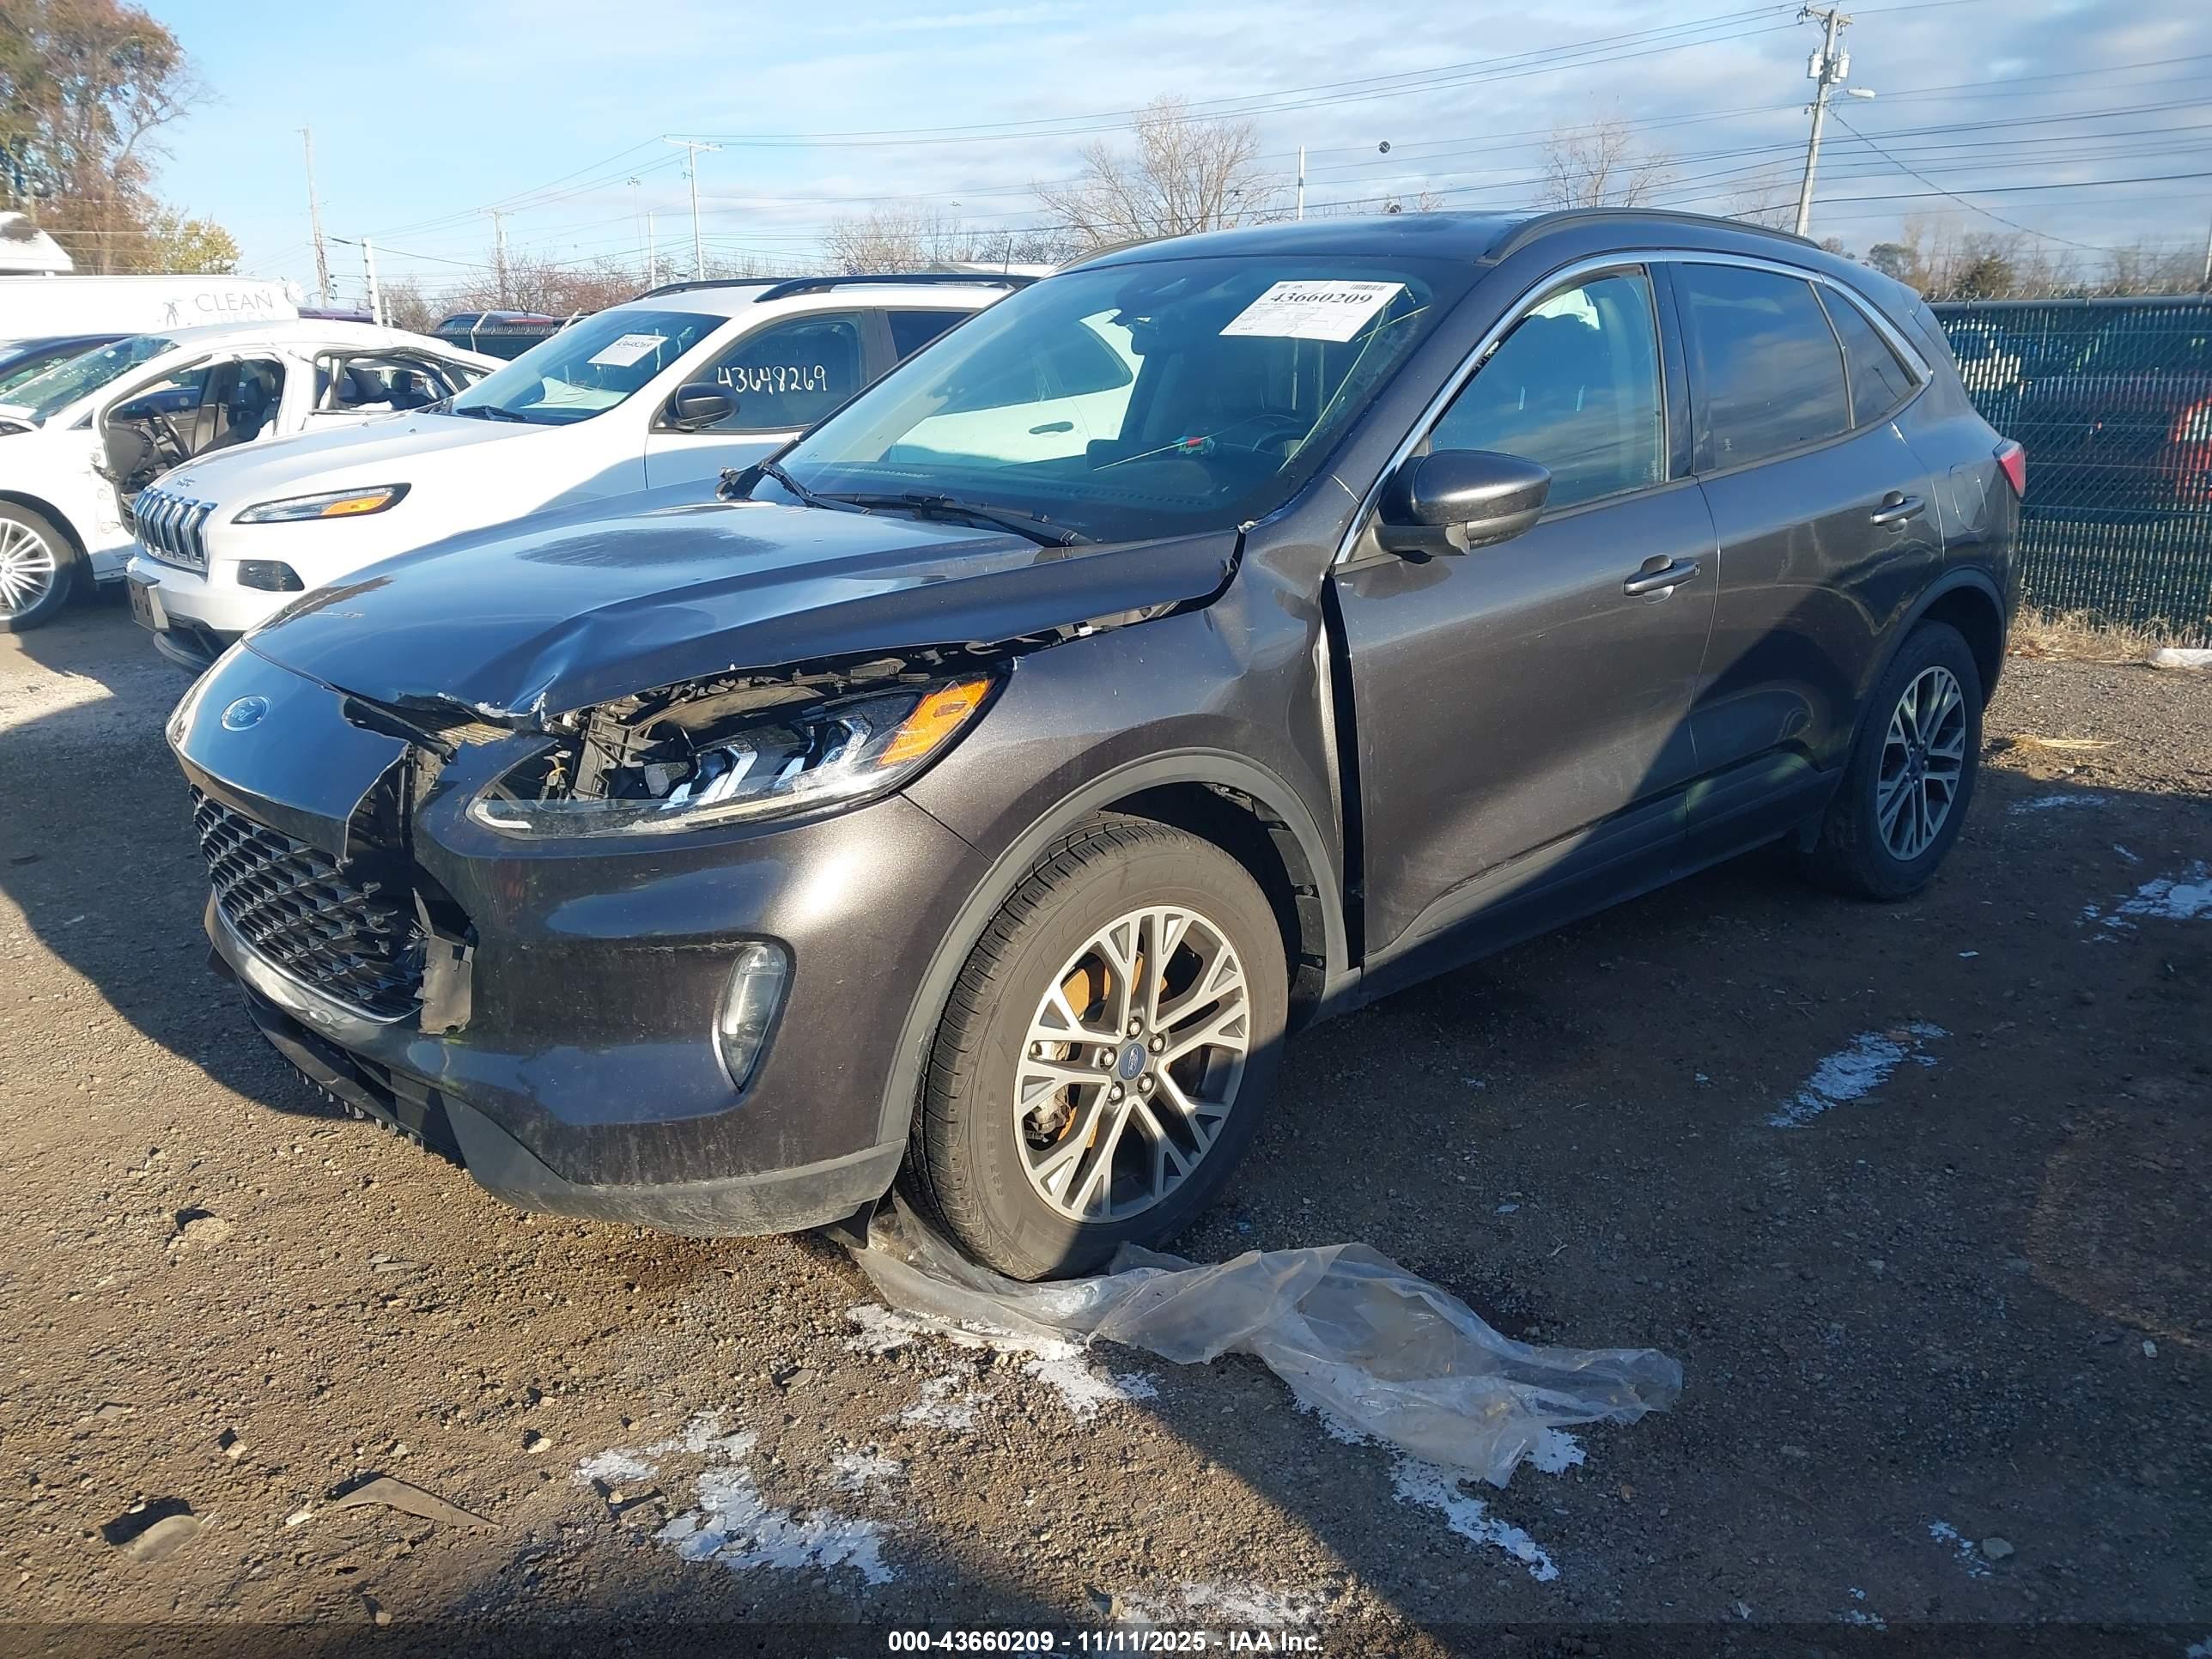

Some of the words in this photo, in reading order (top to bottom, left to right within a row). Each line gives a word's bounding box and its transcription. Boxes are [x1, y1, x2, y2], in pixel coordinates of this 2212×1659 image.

[195, 293, 273, 312] CLEAN
[1269, 291, 1373, 305] 43660209
[717, 365, 827, 395] 43648269
